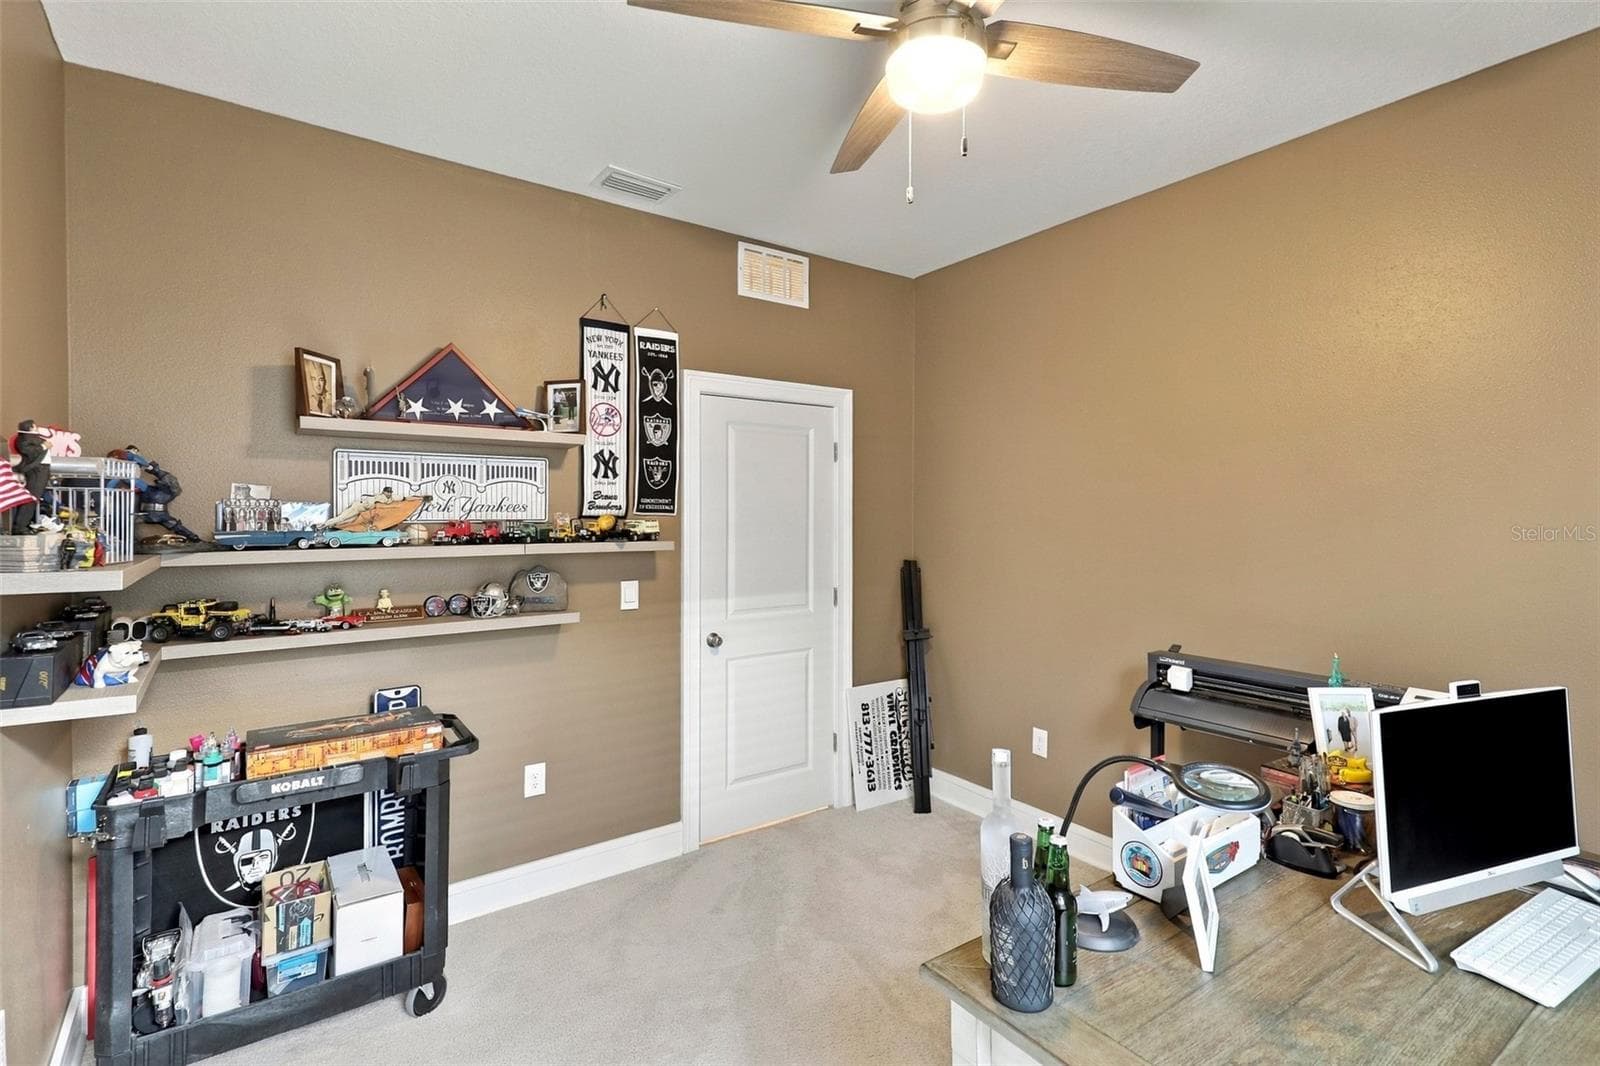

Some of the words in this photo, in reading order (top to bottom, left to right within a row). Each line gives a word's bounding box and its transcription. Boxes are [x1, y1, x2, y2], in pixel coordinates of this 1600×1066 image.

[586, 334, 603, 343] NEW
[604, 335, 624, 347] YORK
[639, 341, 676, 353] RAIDERS
[588, 349, 624, 361] YANKEES
[459, 497, 528, 520] Yankees
[587, 500, 622, 511] Bombers
[886, 692, 897, 726] VINYL
[889, 730, 903, 791] GRAPHICS
[271, 776, 325, 794] KOBALT
[210, 805, 302, 834] RAIDERS
